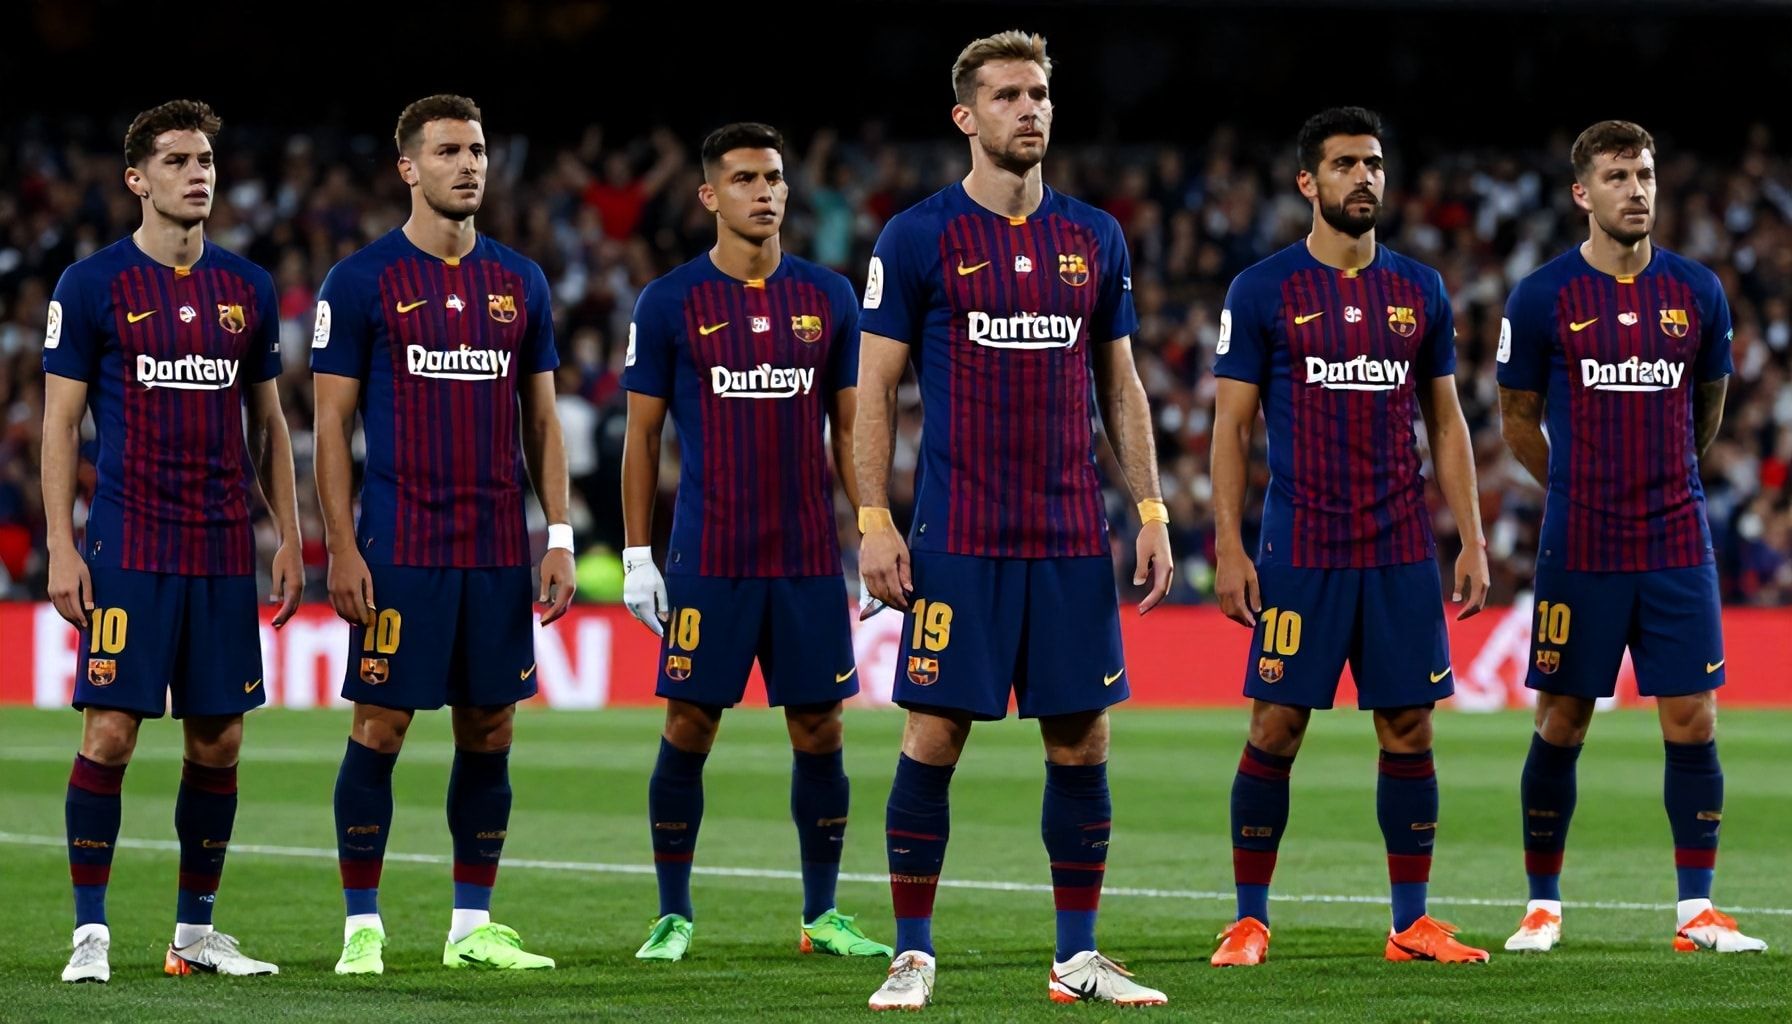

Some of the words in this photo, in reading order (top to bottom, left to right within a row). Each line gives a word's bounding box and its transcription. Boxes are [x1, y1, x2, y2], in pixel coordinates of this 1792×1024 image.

[90, 607, 128, 654] 10
[1260, 606, 1302, 656] 10
[1538, 600, 1571, 645] 10
